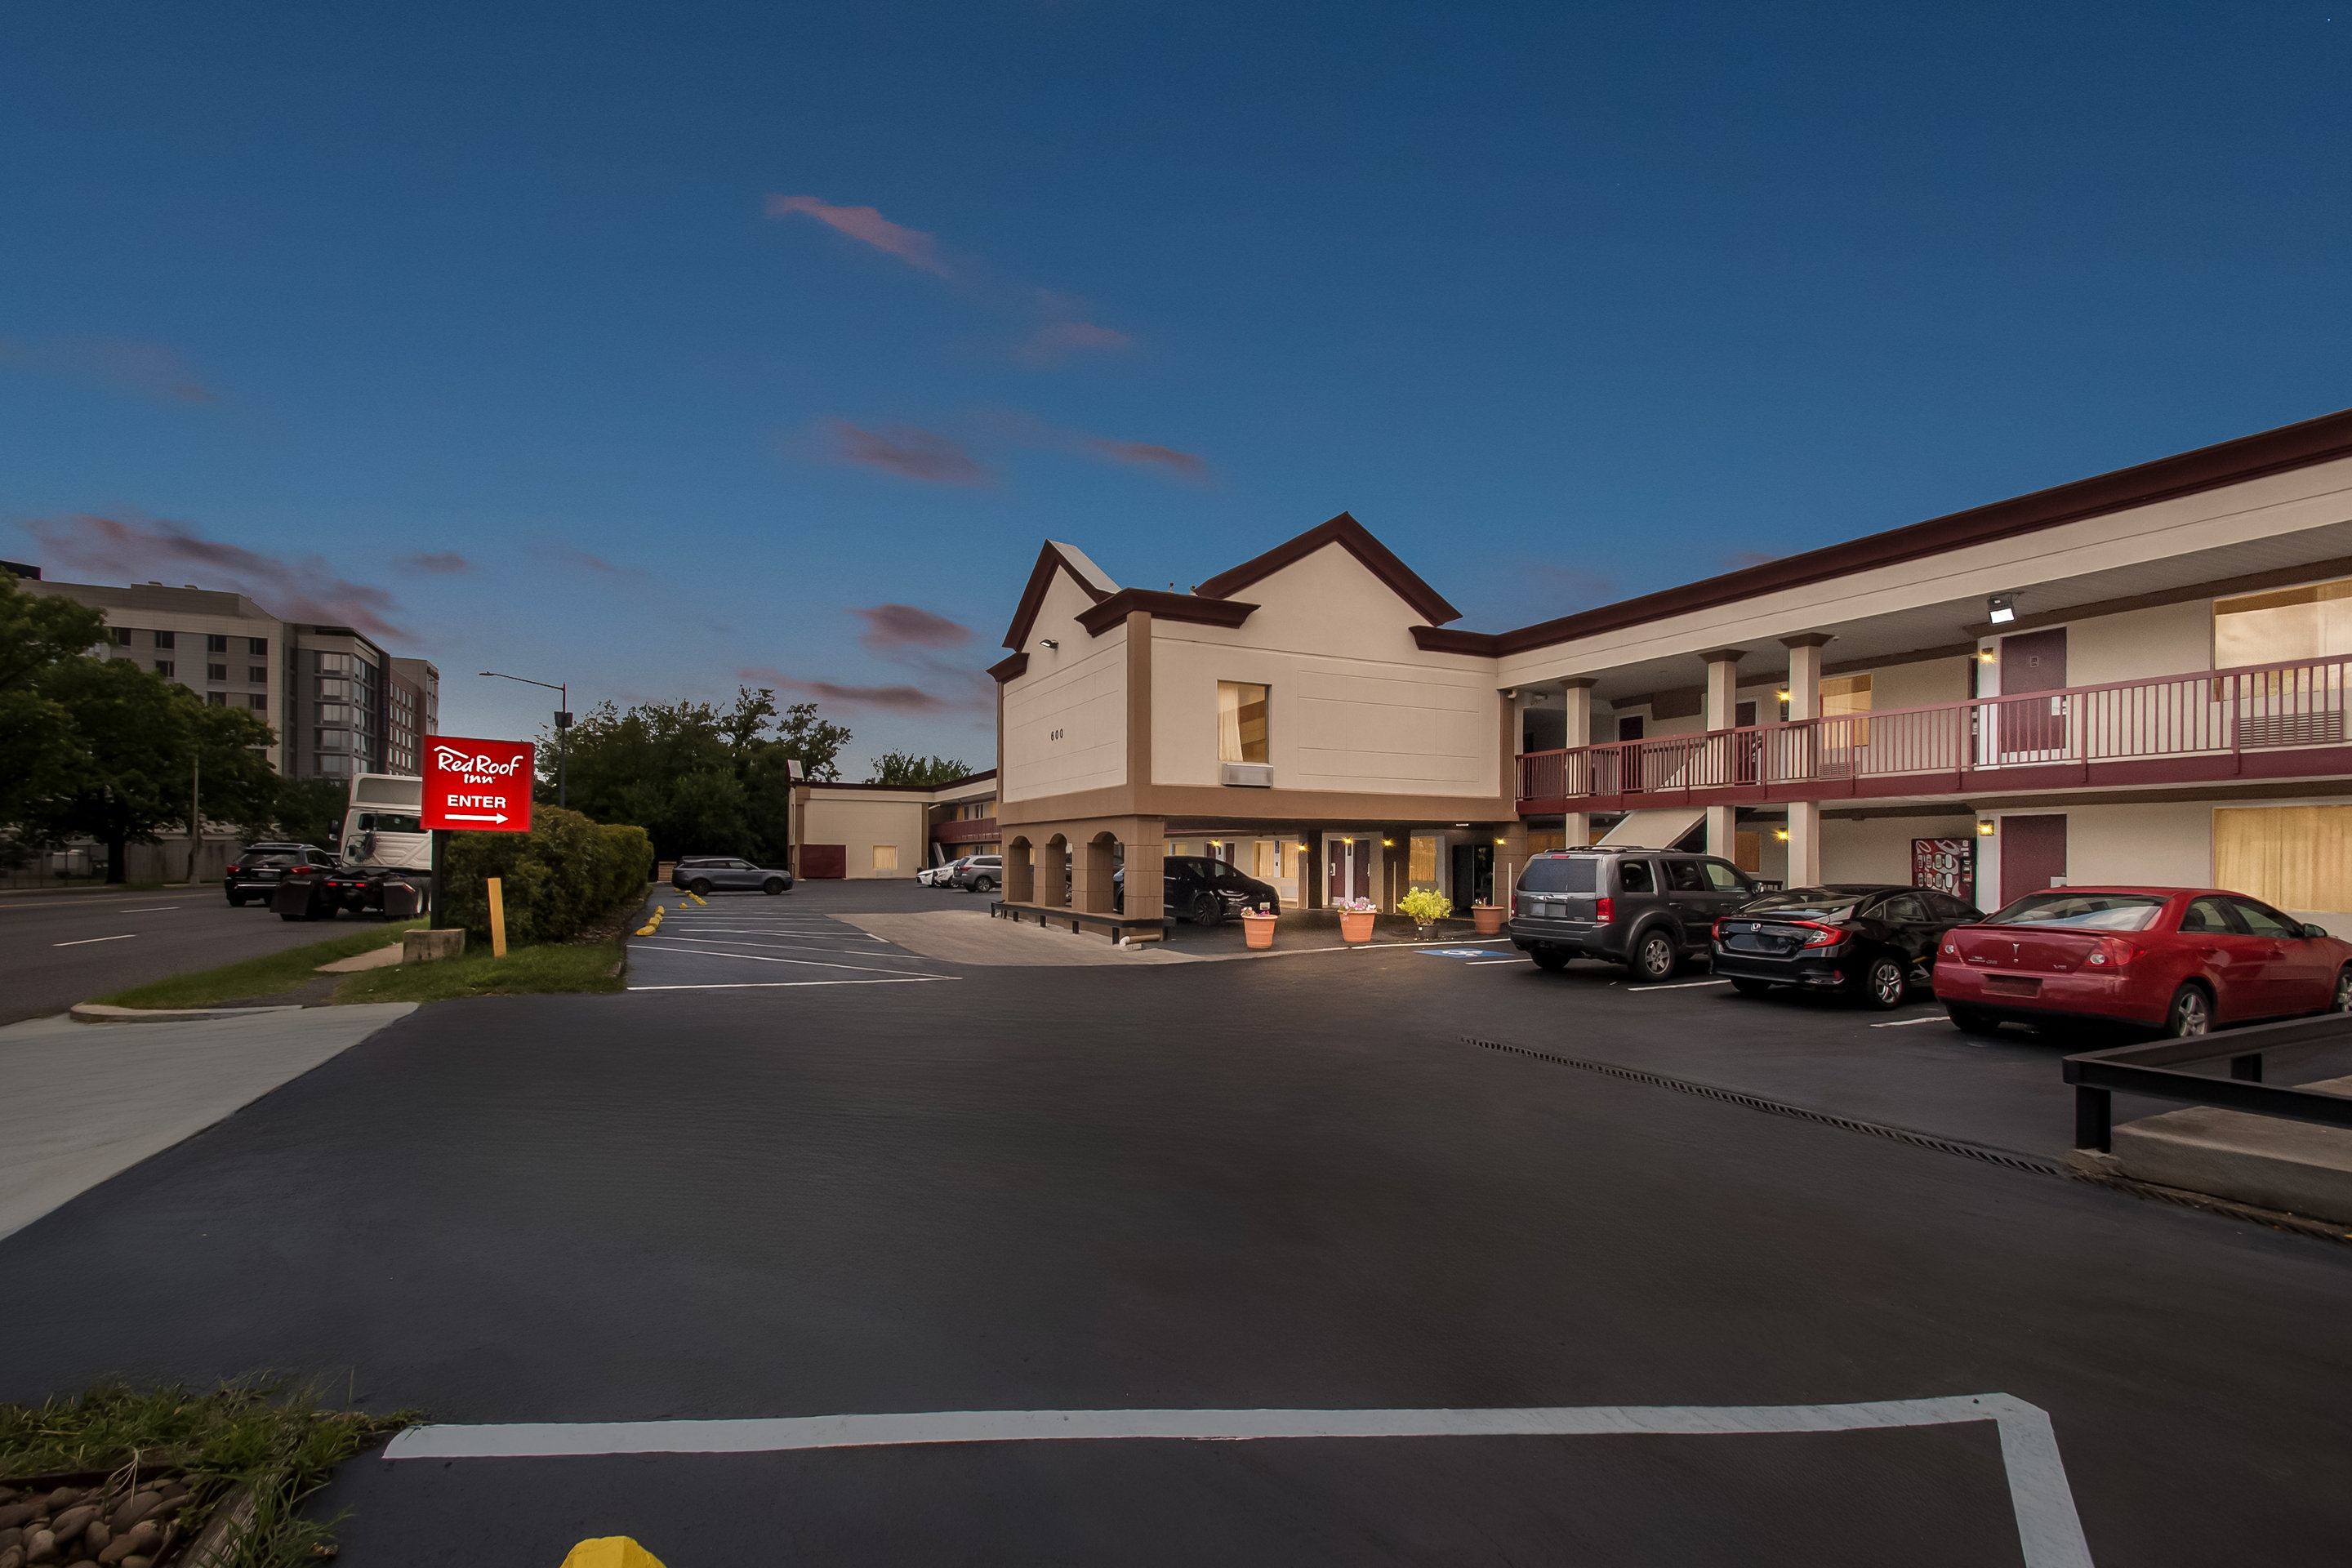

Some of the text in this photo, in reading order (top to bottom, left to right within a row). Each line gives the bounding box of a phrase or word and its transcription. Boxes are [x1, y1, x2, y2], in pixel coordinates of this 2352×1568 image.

[1050, 728, 1064, 742] 600
[438, 752, 523, 776] Red Roof
[464, 773, 493, 784] Inn
[447, 794, 506, 808] ENTER
